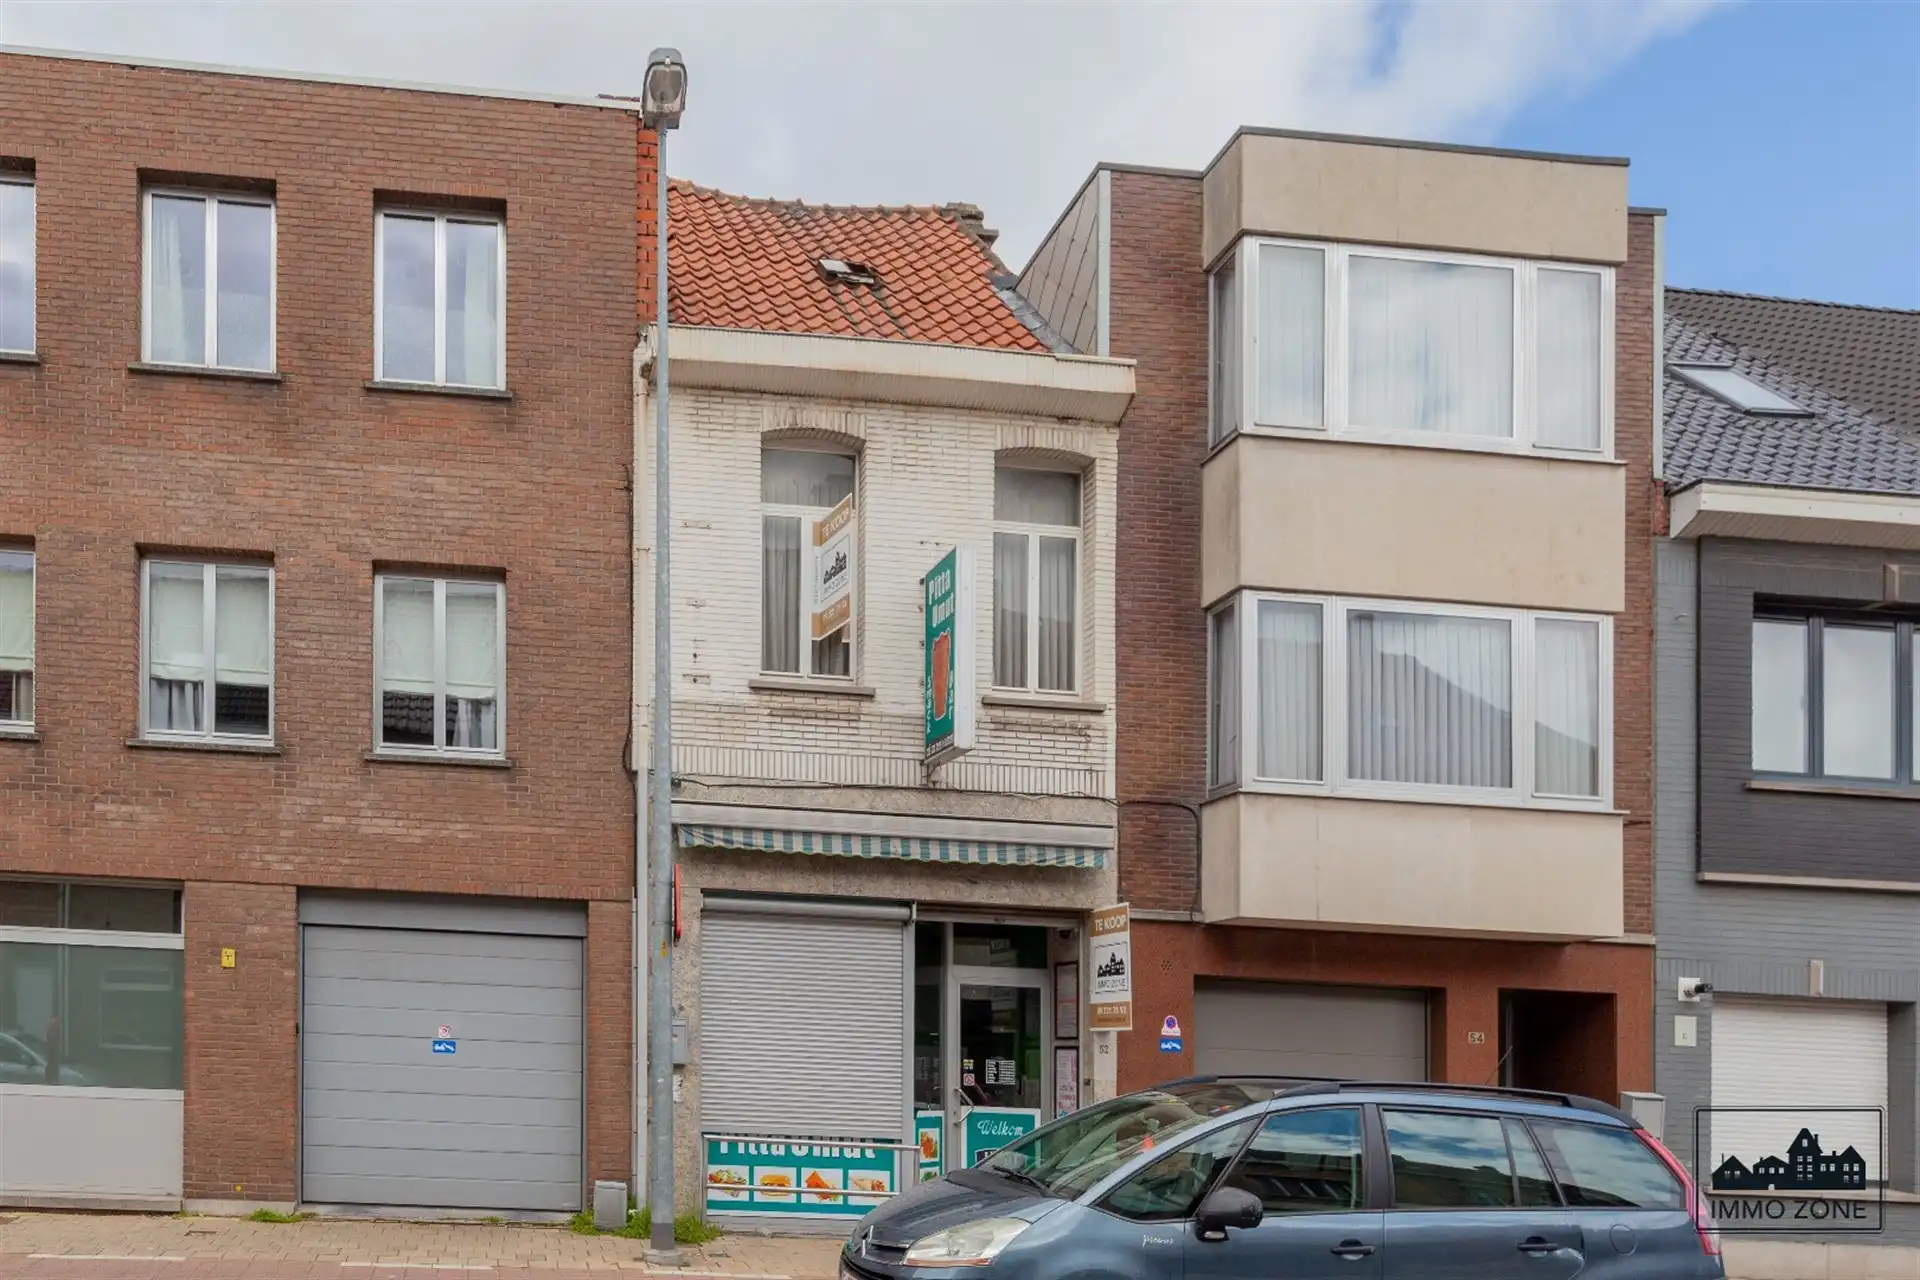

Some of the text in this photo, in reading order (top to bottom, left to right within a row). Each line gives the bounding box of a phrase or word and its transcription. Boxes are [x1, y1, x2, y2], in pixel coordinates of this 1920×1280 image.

[1094, 914, 1127, 931] TE KOOP
[1469, 1032, 1484, 1044] 54
[1099, 1044, 1109, 1054] 52
[977, 1119, 1024, 1136] Welkom
